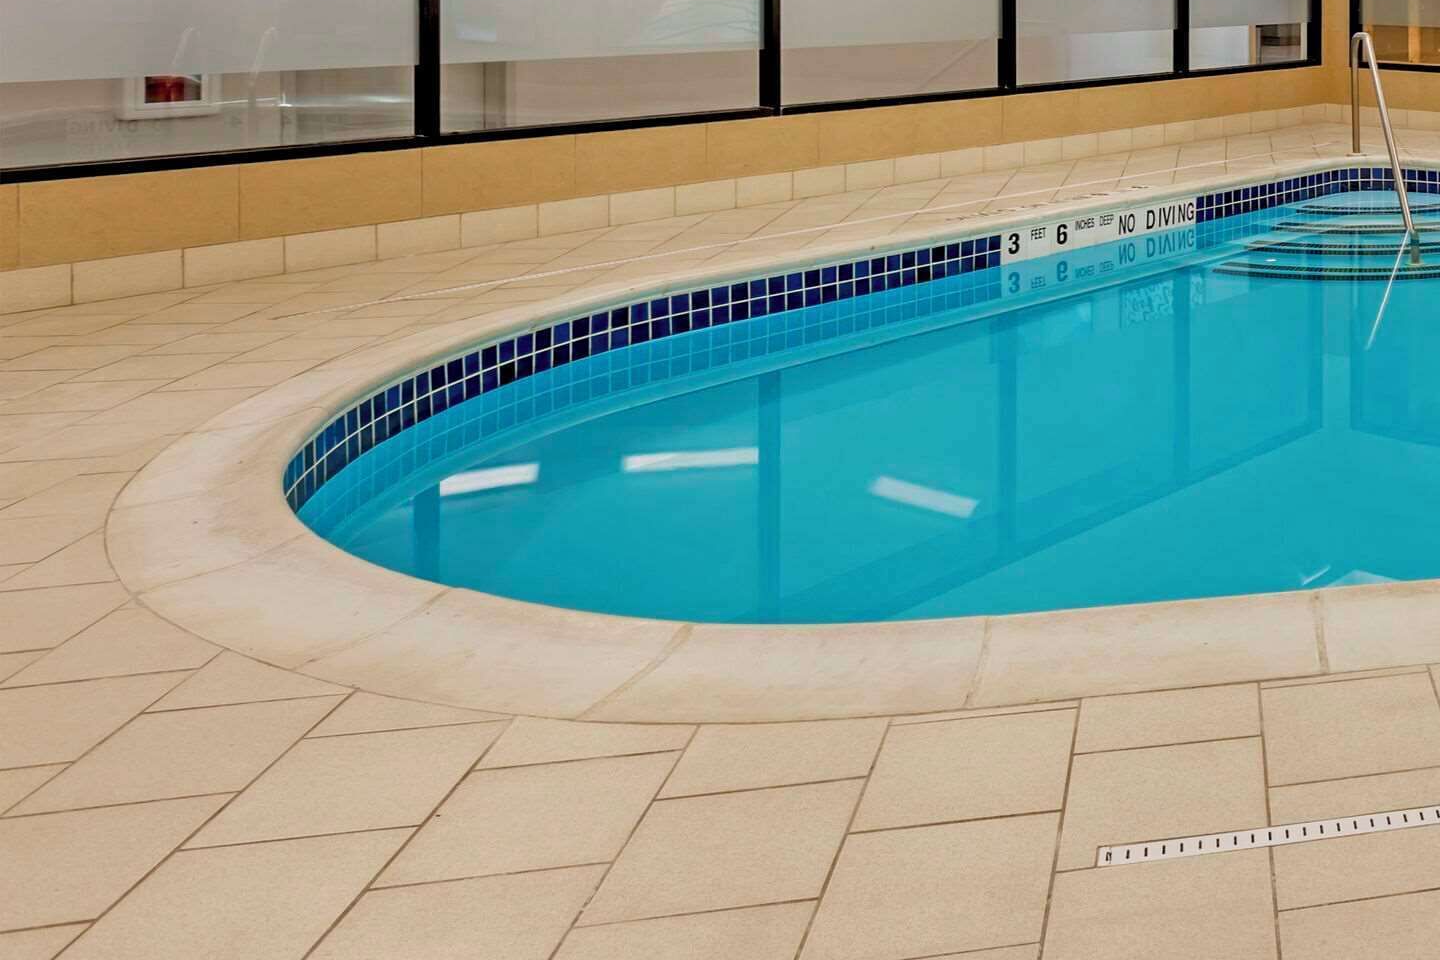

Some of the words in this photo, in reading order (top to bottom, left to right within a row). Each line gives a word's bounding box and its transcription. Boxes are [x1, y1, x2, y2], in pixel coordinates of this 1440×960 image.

[1008, 233, 1020, 254] 3
[1030, 227, 1047, 240] FEET
[1056, 224, 1068, 244] 6
[1075, 217, 1095, 231] INCHES
[1099, 214, 1114, 226] DEEP
[1118, 213, 1136, 235] NO
[1146, 202, 1194, 230] DIVING
